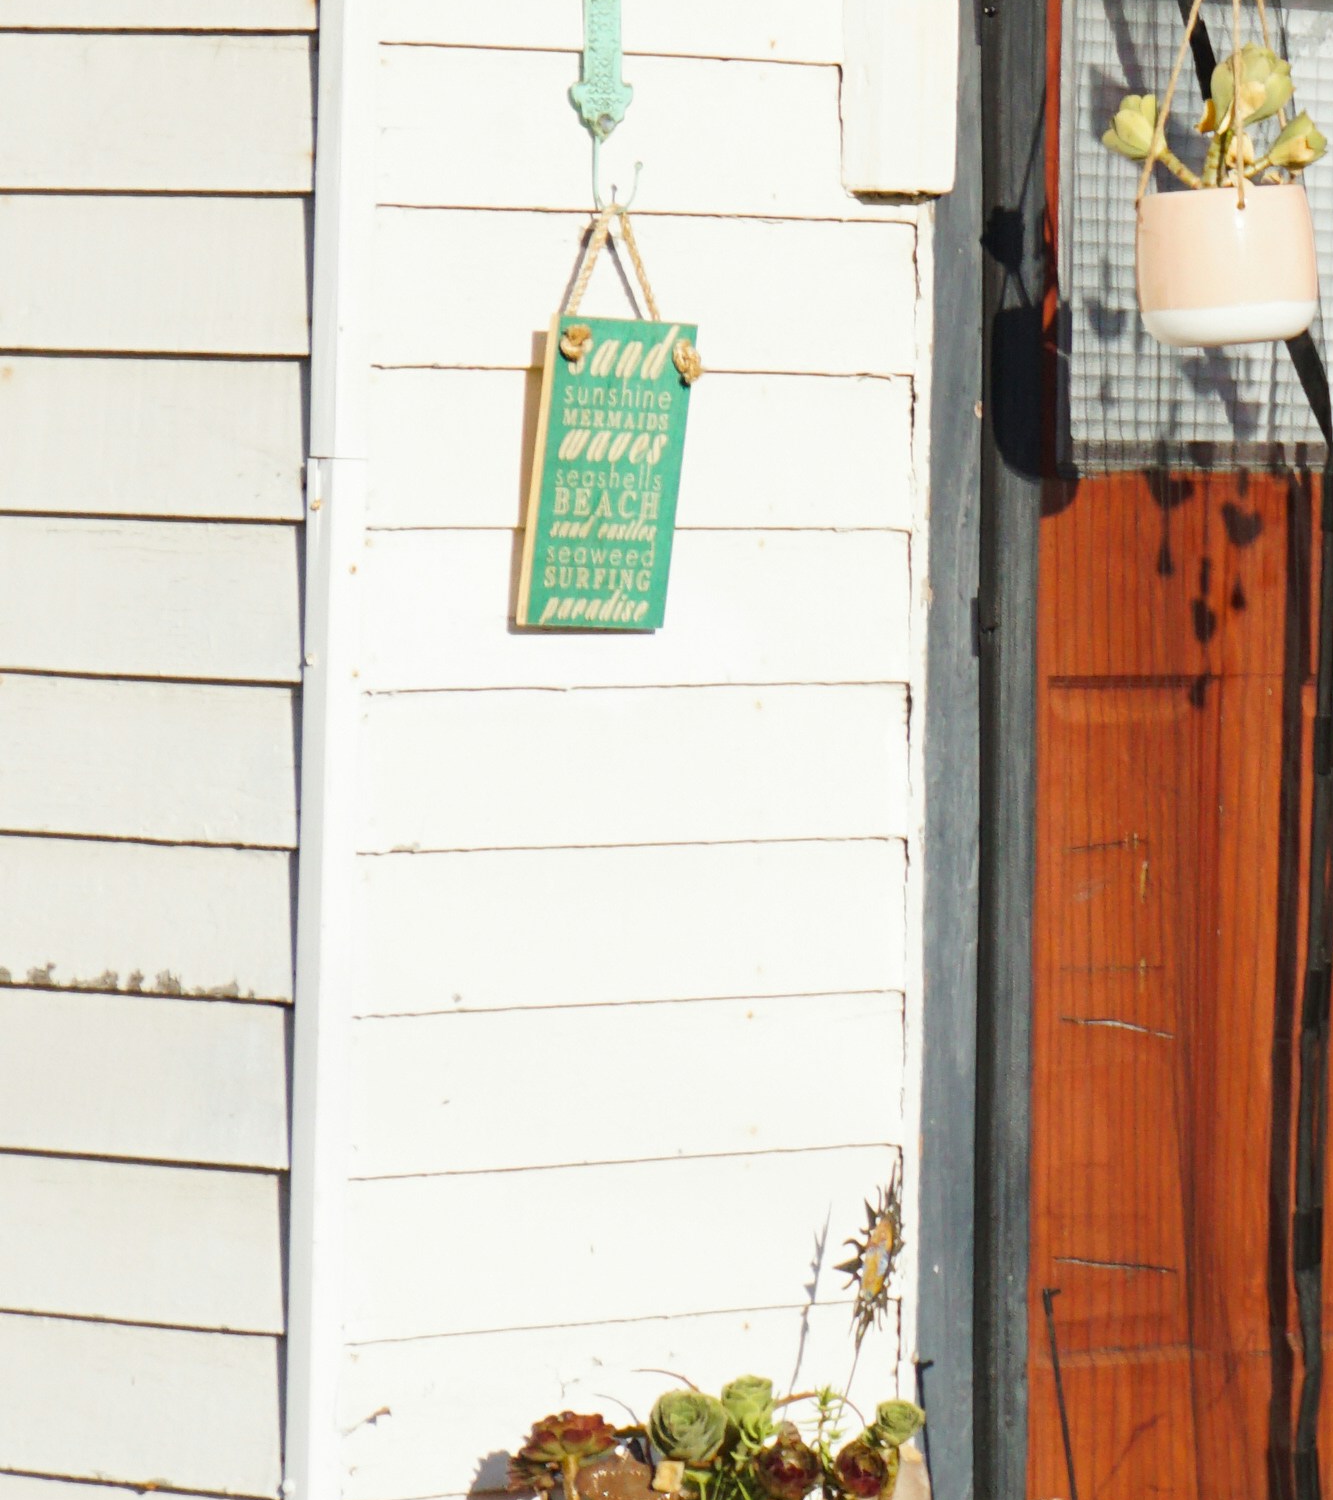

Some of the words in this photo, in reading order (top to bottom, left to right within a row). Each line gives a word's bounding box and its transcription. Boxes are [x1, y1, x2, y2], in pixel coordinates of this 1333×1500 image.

[563, 380, 673, 410] sunshine
[562, 408, 670, 431] MERMAIDS
[557, 428, 669, 465] waves
[555, 464, 663, 491] seashells
[553, 486, 661, 520] BEACH
[549, 516, 596, 538] sand
[546, 537, 656, 568] seaweed
[543, 565, 652, 592] SURFING
[539, 590, 649, 625] paradise
